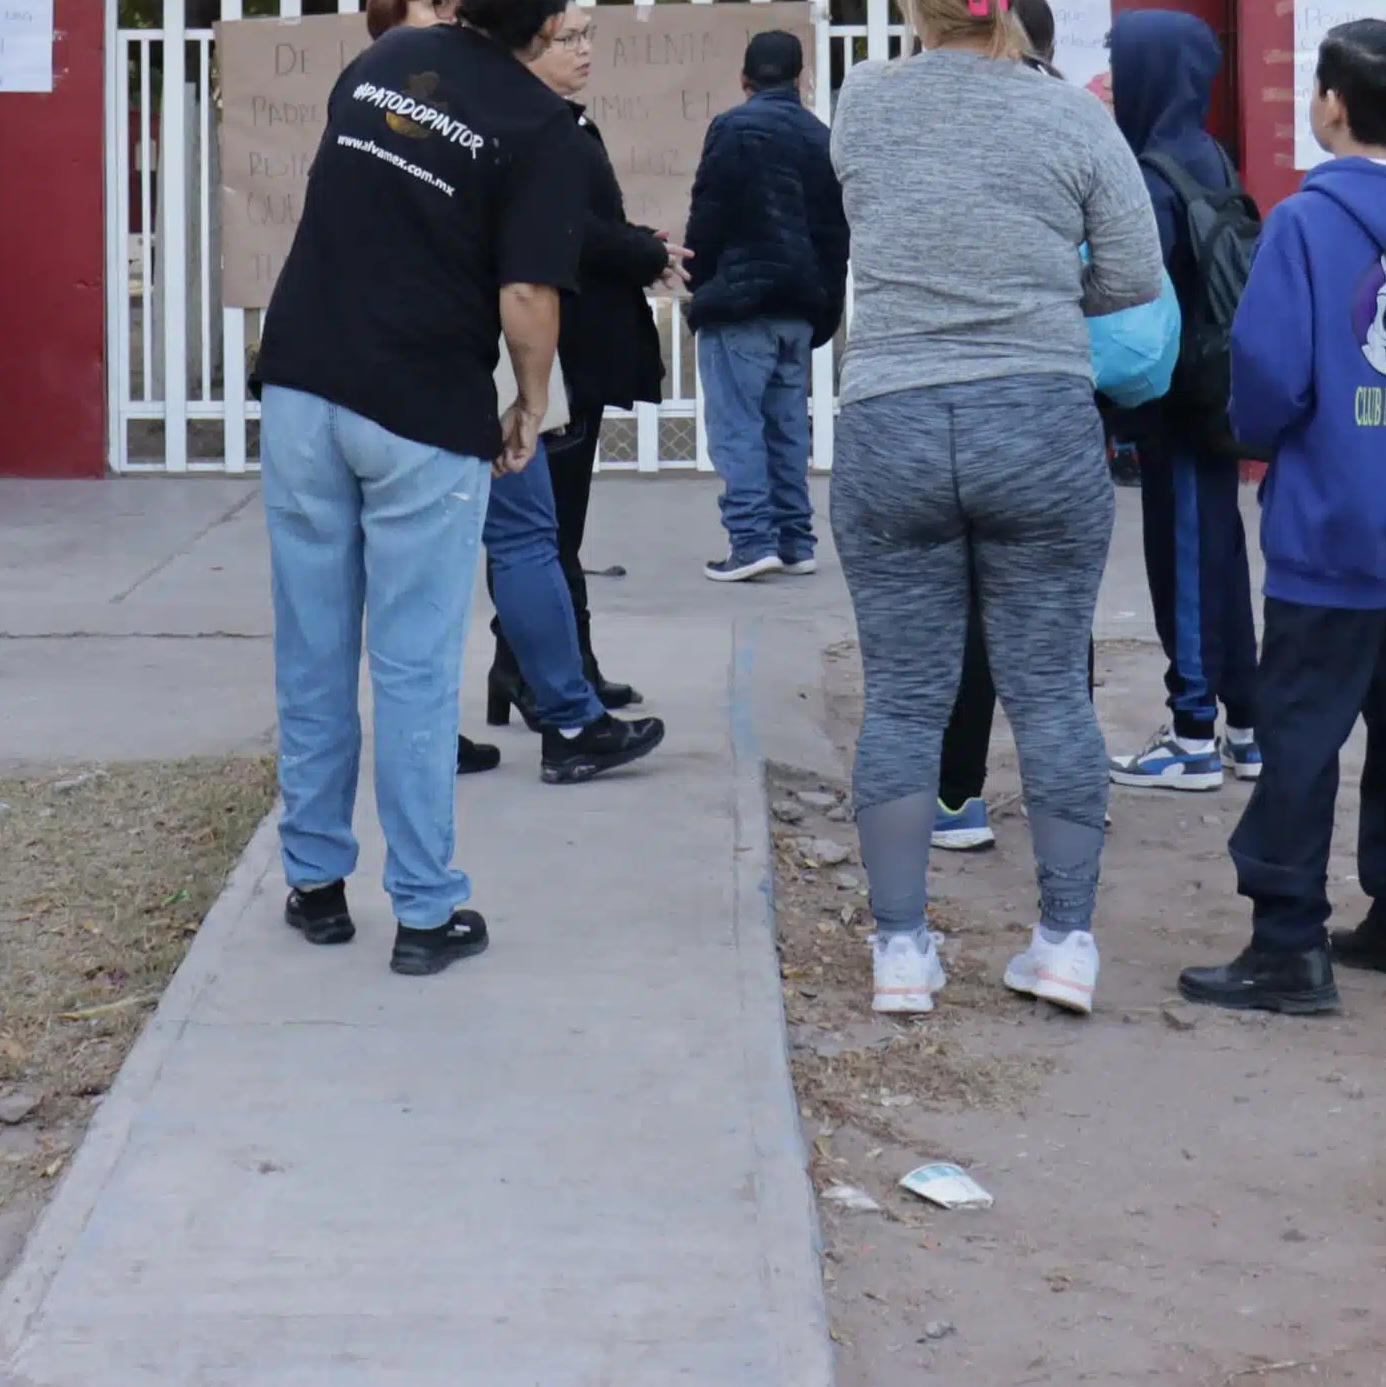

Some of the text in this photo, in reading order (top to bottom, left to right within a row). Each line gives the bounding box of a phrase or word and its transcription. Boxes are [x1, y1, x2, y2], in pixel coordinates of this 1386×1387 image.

[274, 42, 313, 76] DE
[353, 81, 485, 159] #PATODOPINTOR
[336, 134, 456, 198] www.alvamex.com.mx
[1355, 385, 1382, 427] CLUB
